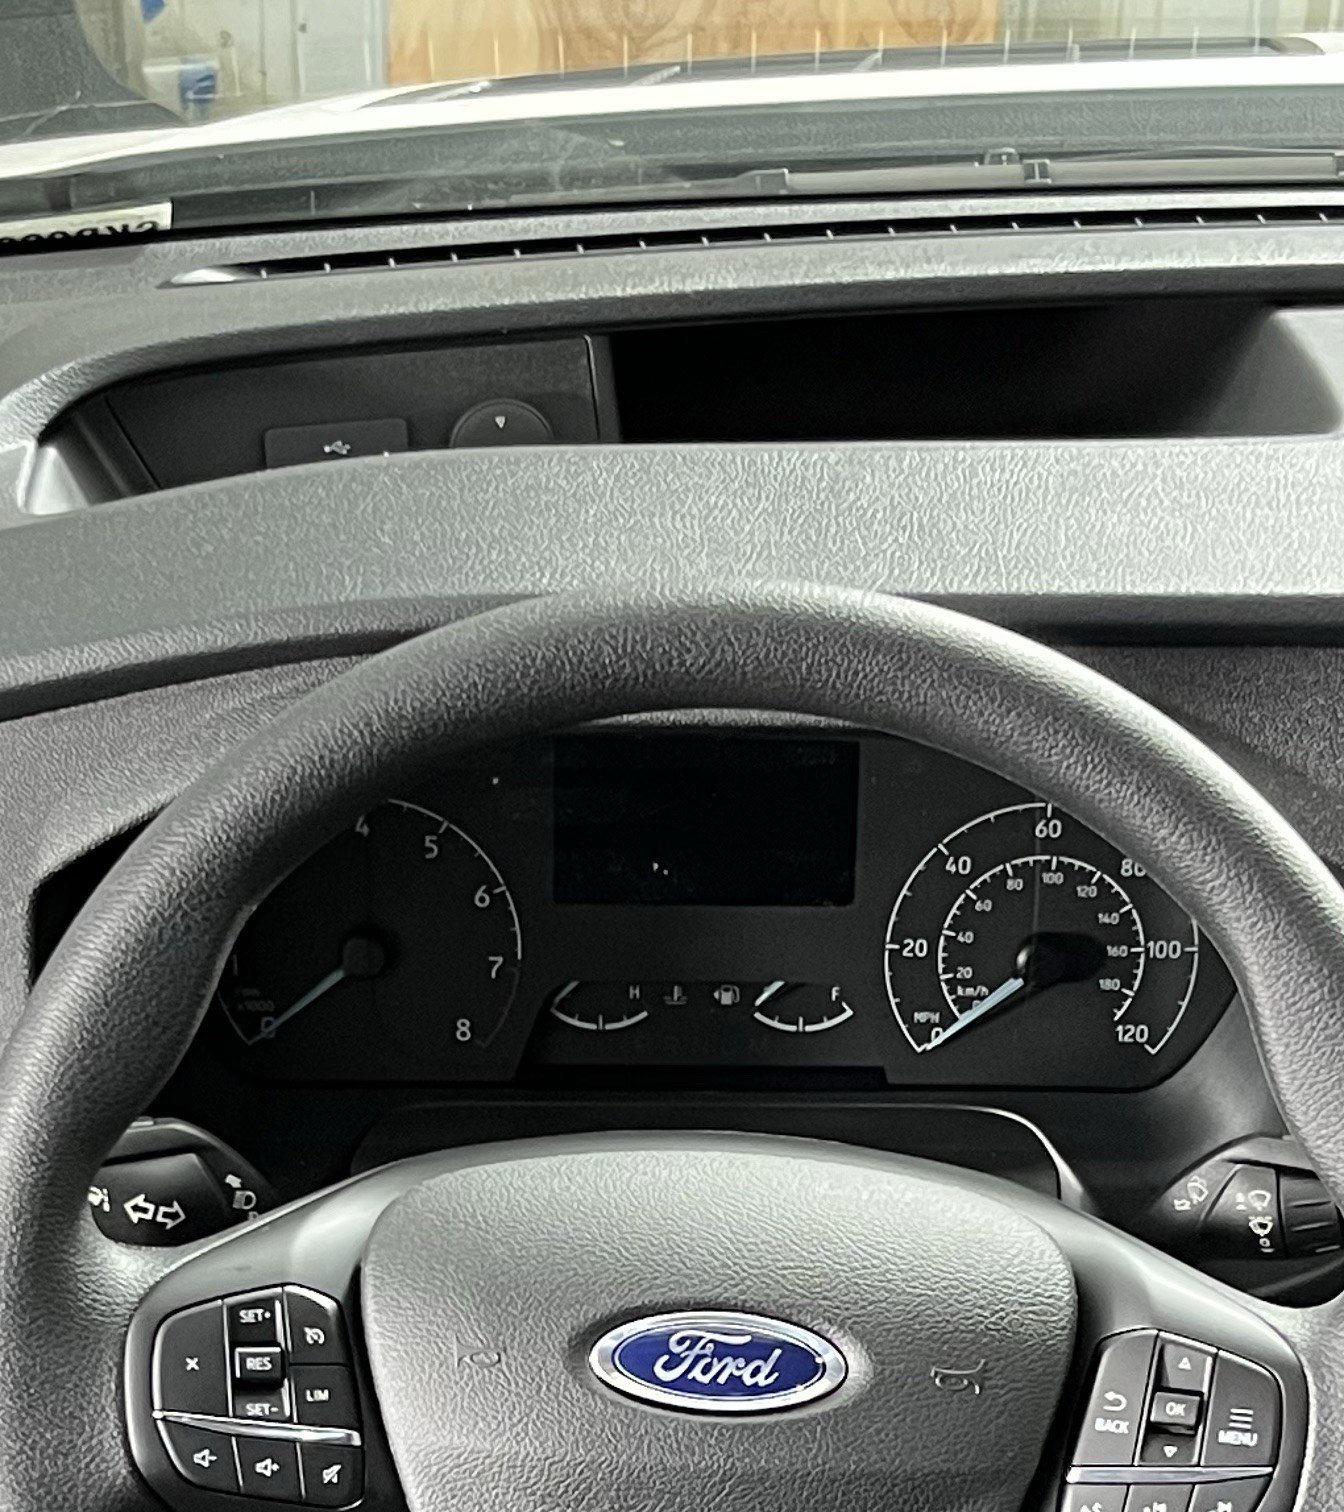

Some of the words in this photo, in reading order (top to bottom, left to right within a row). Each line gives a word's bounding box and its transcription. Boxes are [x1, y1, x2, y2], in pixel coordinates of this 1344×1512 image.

[1034, 819, 1062, 839] 60
[424, 836, 439, 859] 5
[945, 856, 972, 875] 40
[1006, 878, 1023, 891] 80
[1041, 872, 1064, 885] 100
[473, 885, 490, 908] 6
[1076, 885, 1098, 898] 120
[975, 900, 992, 912] 60
[1098, 912, 1120, 925] 140
[957, 931, 974, 944] 40
[902, 939, 928, 957] 20
[1106, 945, 1128, 957] 160
[1146, 940, 1181, 959] 100
[488, 956, 504, 979] 7
[956, 967, 972, 979] 20
[629, 986, 640, 999] H
[957, 985, 989, 997] km/h
[1099, 979, 1121, 991] 180
[831, 986, 842, 1001] F
[913, 1011, 940, 1024] MPH
[456, 1019, 471, 1042] 8
[1114, 1024, 1149, 1043] 120
[246, 1356, 272, 1371] RES
[653, 1329, 782, 1387] Ford
[306, 1388, 329, 1402] LIM
[1165, 1402, 1185, 1417] OK
[1095, 1418, 1130, 1434] BACK
[1218, 1430, 1258, 1447] MENU
